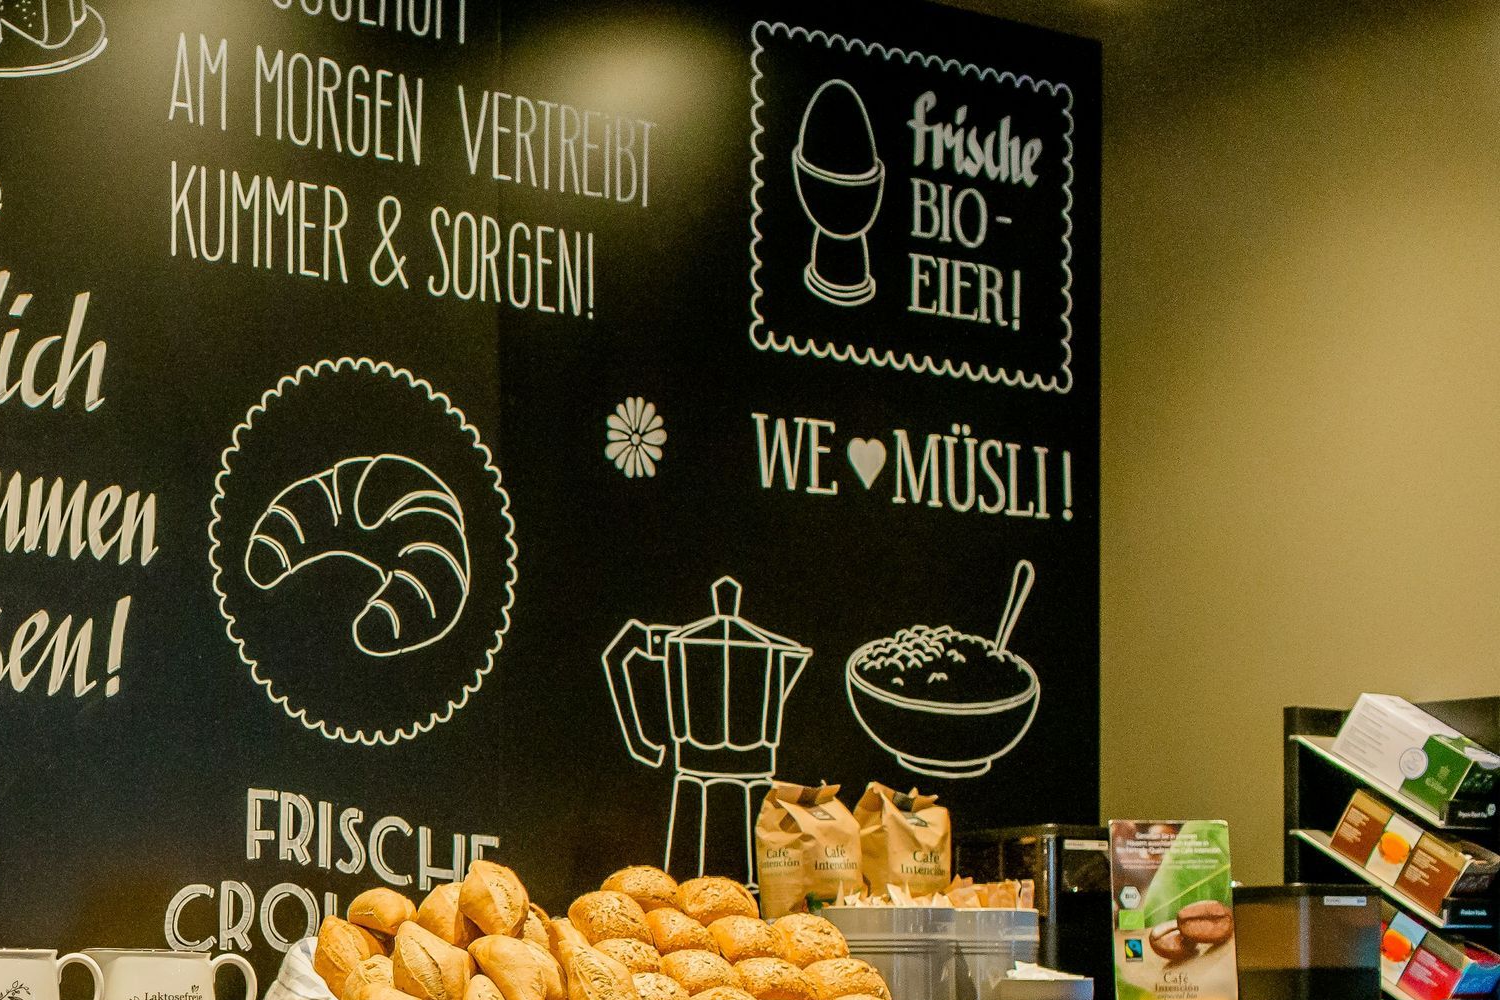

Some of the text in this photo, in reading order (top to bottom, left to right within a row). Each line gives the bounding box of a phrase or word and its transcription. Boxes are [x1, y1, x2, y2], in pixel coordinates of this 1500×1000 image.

[168, 32, 229, 132] AM
[253, 43, 425, 168] MORGEN
[905, 90, 1044, 188] frische
[169, 159, 596, 320] KUMMER & SORGEN!
[906, 251, 1022, 332] EIER!
[750, 411, 1075, 522] WE MÜSLI!
